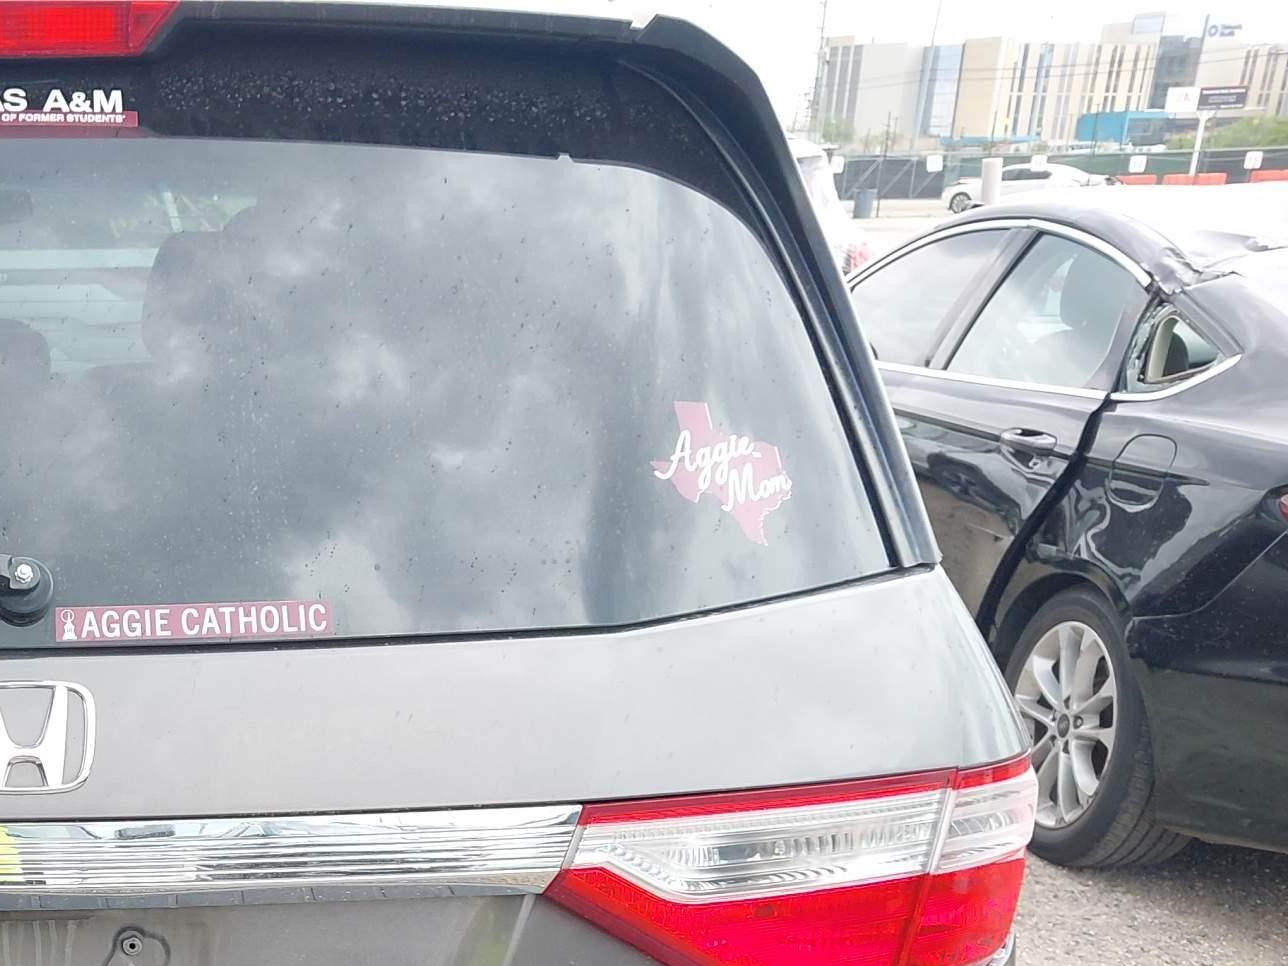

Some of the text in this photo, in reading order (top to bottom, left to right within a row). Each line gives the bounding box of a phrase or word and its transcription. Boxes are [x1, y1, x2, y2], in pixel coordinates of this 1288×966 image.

[1, 113, 17, 123] OF
[18, 113, 64, 123] FORMER
[42, 88, 123, 113] A&M
[654, 429, 761, 490] Aggie
[721, 462, 793, 512] Mom
[80, 603, 328, 639] AGGIE CATHOLIC
